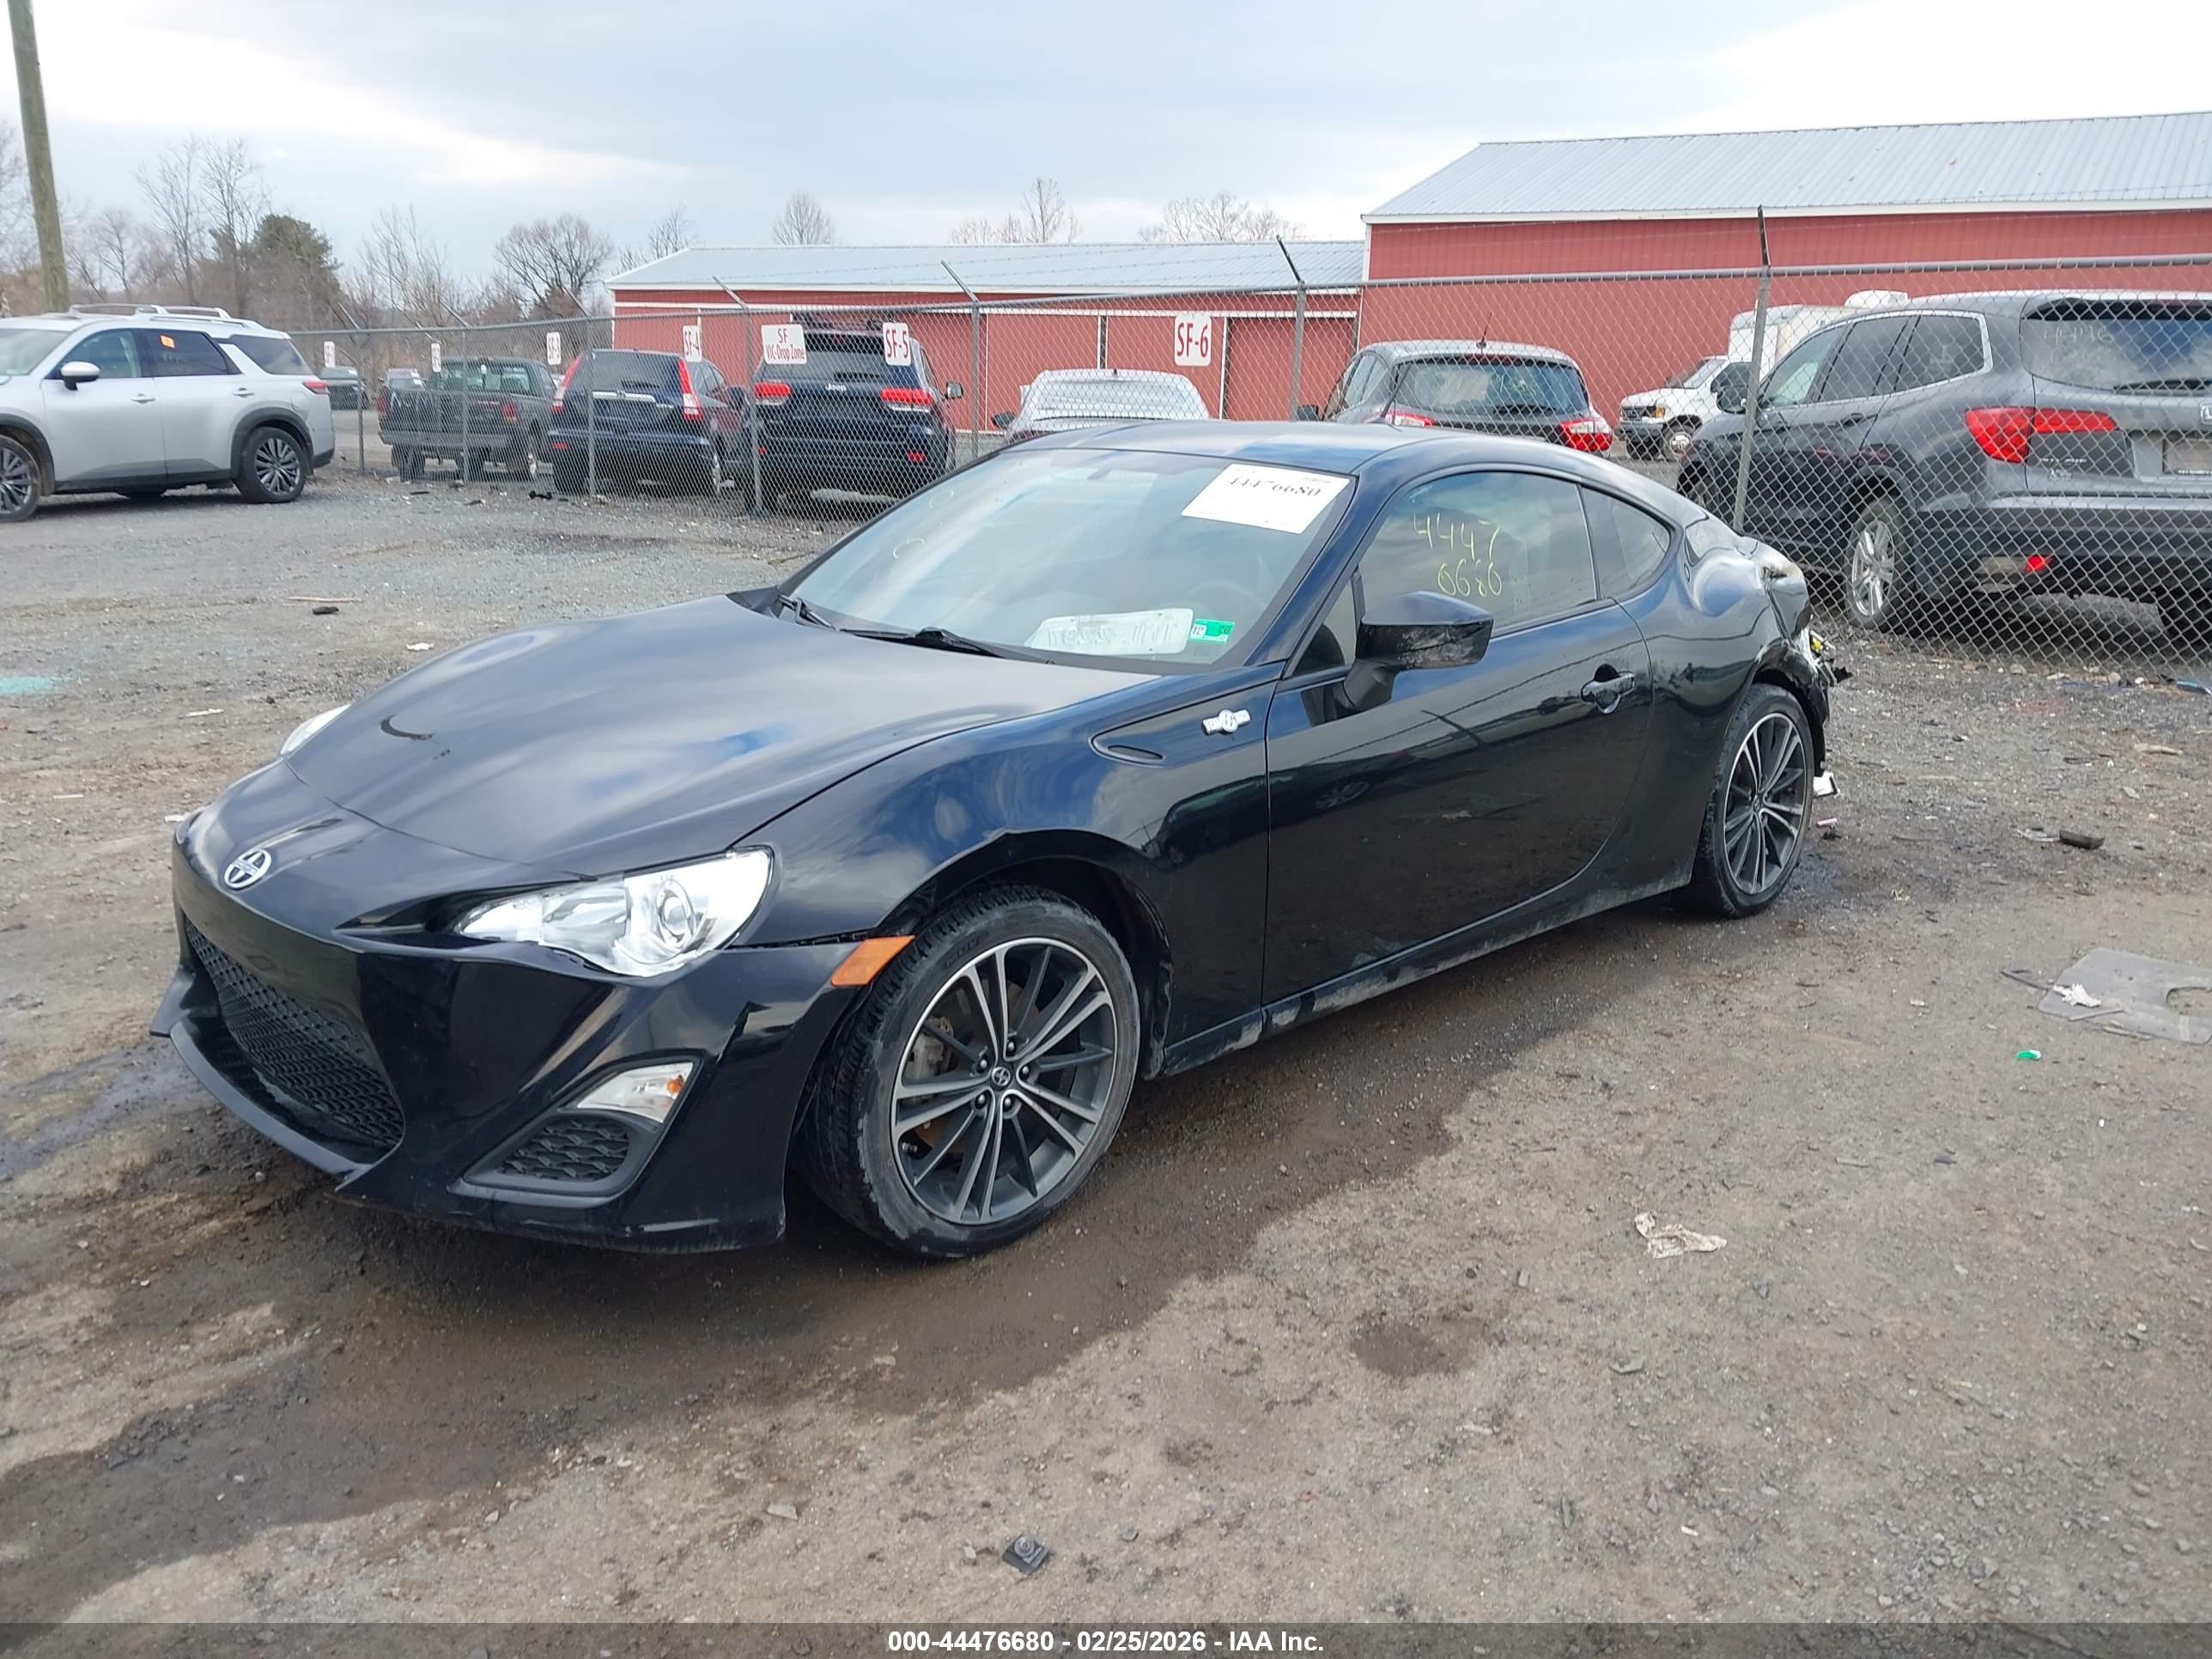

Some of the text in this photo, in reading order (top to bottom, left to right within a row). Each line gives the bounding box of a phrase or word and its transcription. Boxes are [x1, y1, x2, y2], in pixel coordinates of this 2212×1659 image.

[777, 328, 788, 343] SF
[885, 329, 908, 358] SF-5
[1177, 322, 1208, 357] SF-6
[790, 343, 805, 360] Zone
[1413, 512, 1501, 562] 4447
